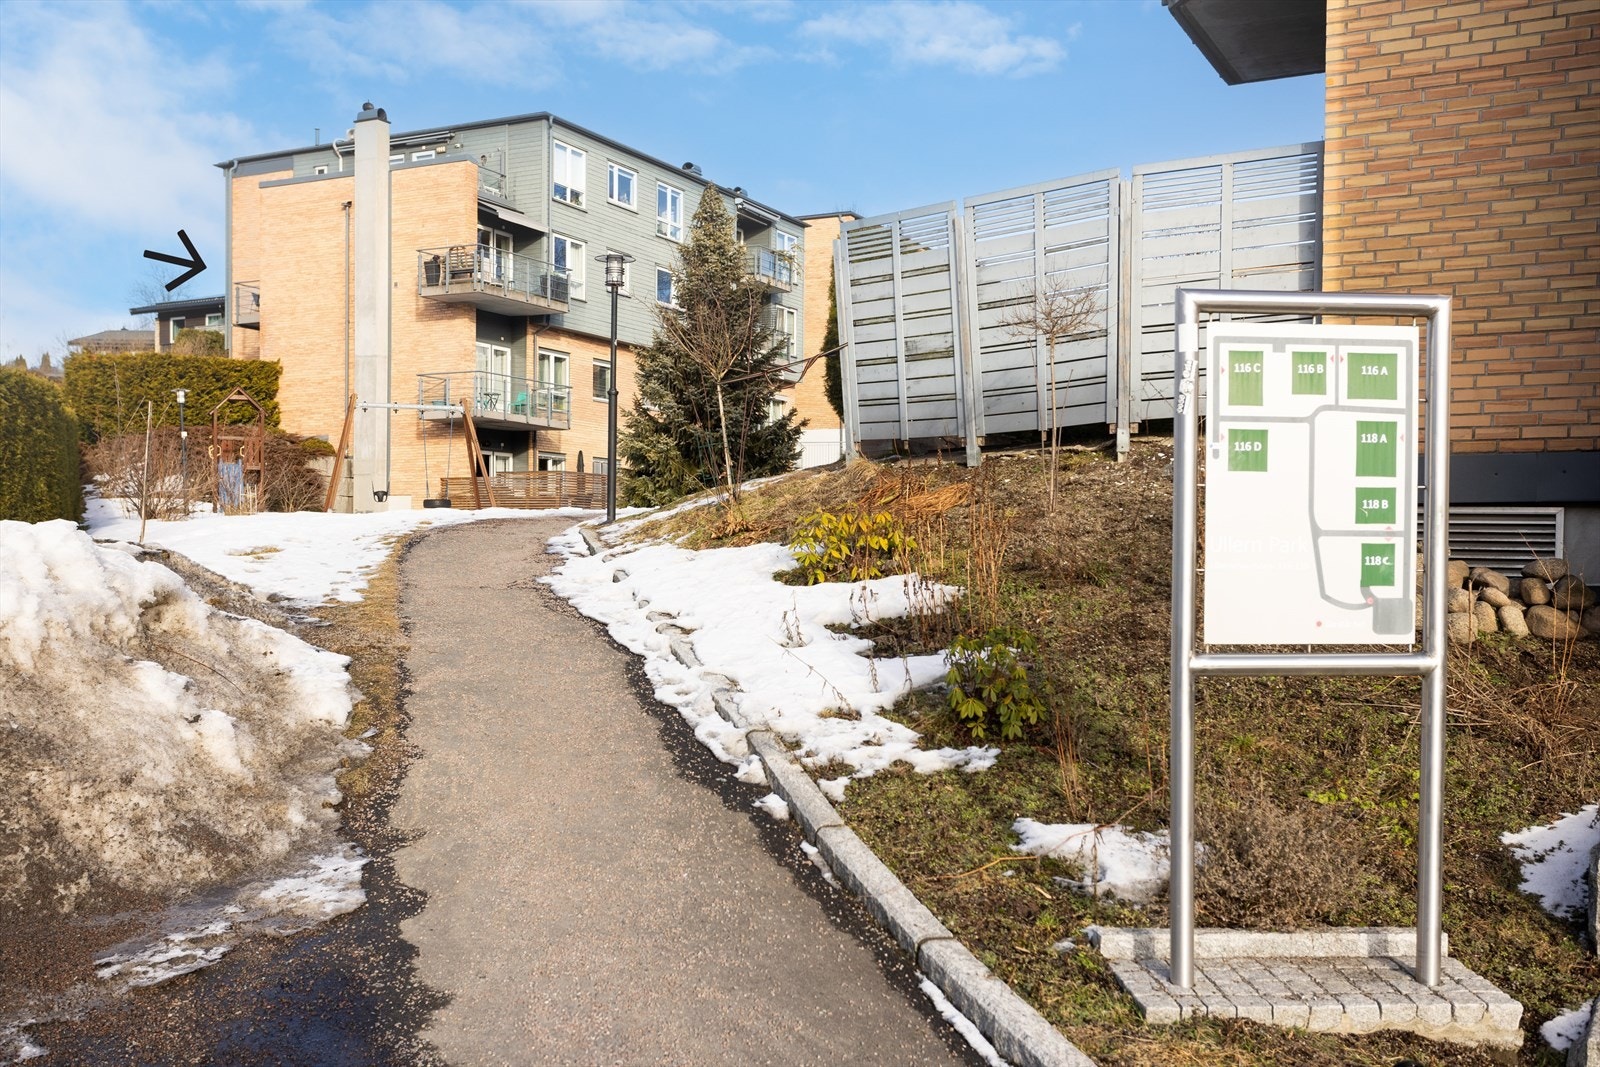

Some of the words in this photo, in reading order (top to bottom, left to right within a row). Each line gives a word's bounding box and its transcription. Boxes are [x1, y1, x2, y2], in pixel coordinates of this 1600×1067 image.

[1234, 363, 1252, 372] 116
[1254, 363, 1261, 372] C
[1298, 364, 1315, 374] 116
[1316, 364, 1324, 374] B
[1361, 366, 1379, 375] 116
[1380, 366, 1388, 376] A
[1361, 433, 1379, 443] 118
[1379, 434, 1388, 444] A
[1234, 442, 1252, 451] 116
[1253, 442, 1262, 451] D
[1362, 500, 1380, 509] 118
[1381, 500, 1388, 509] B
[1270, 536, 1309, 552] Park
[1364, 556, 1382, 566] 118
